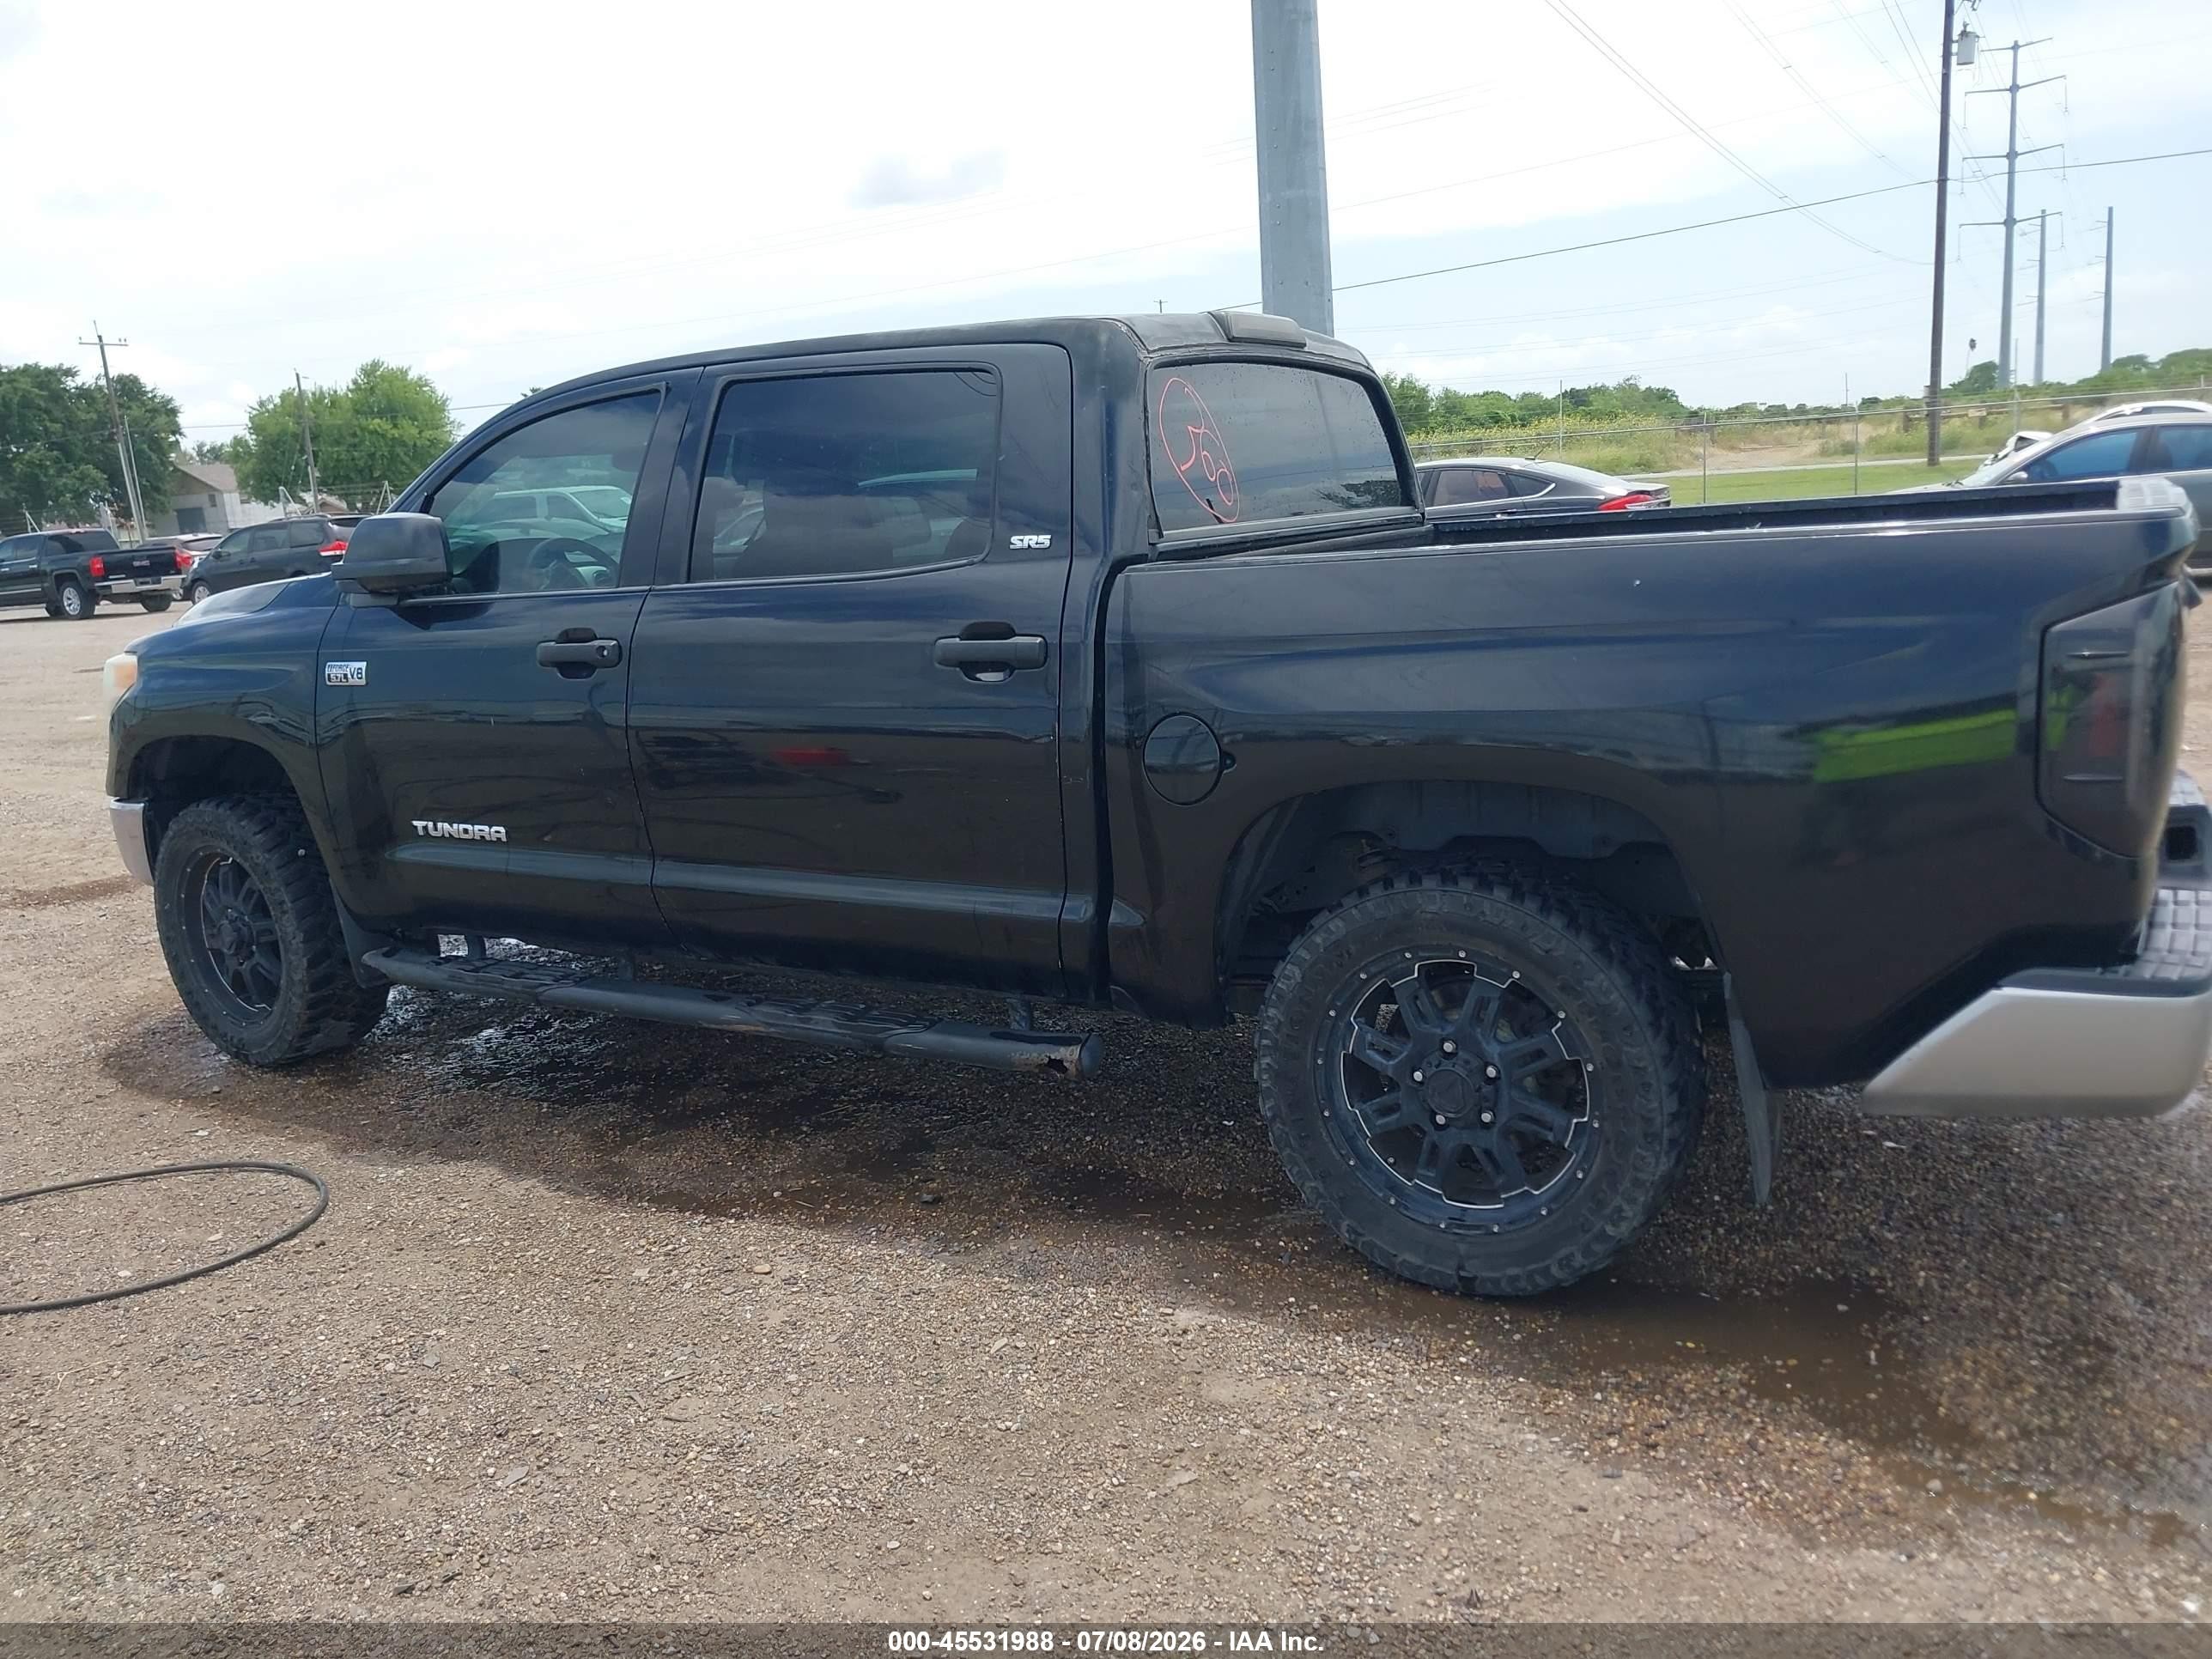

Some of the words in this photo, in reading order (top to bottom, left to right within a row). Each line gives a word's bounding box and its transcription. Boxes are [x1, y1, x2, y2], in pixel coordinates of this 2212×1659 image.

[1009, 534, 1052, 550] SR5
[349, 666, 363, 680] V8
[411, 820, 507, 842] TUNDRA
